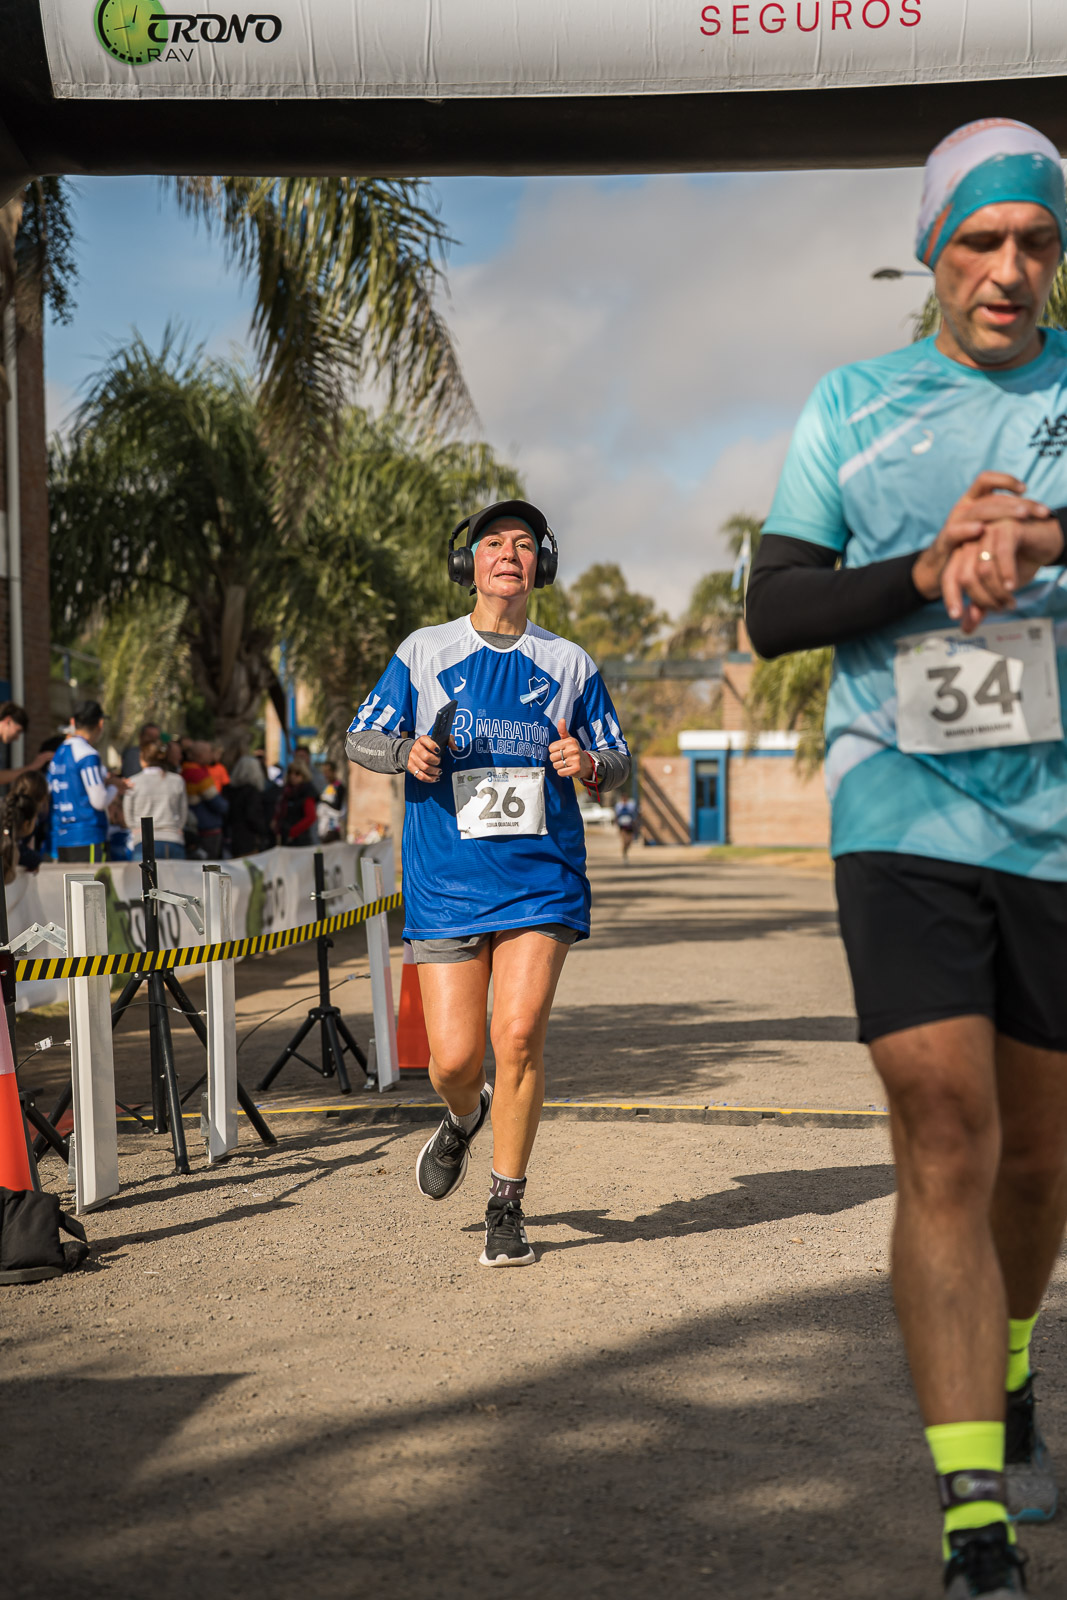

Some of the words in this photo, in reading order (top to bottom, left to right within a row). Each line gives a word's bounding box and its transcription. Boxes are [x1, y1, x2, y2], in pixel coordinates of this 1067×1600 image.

[147, 13, 282, 43] CRONO
[699, 0, 922, 36] SEGUROS
[147, 48, 194, 62] RAV
[926, 658, 1023, 722] 34
[449, 708, 474, 760] 3
[475, 718, 550, 746] MARATÓN
[477, 786, 526, 821] 26
